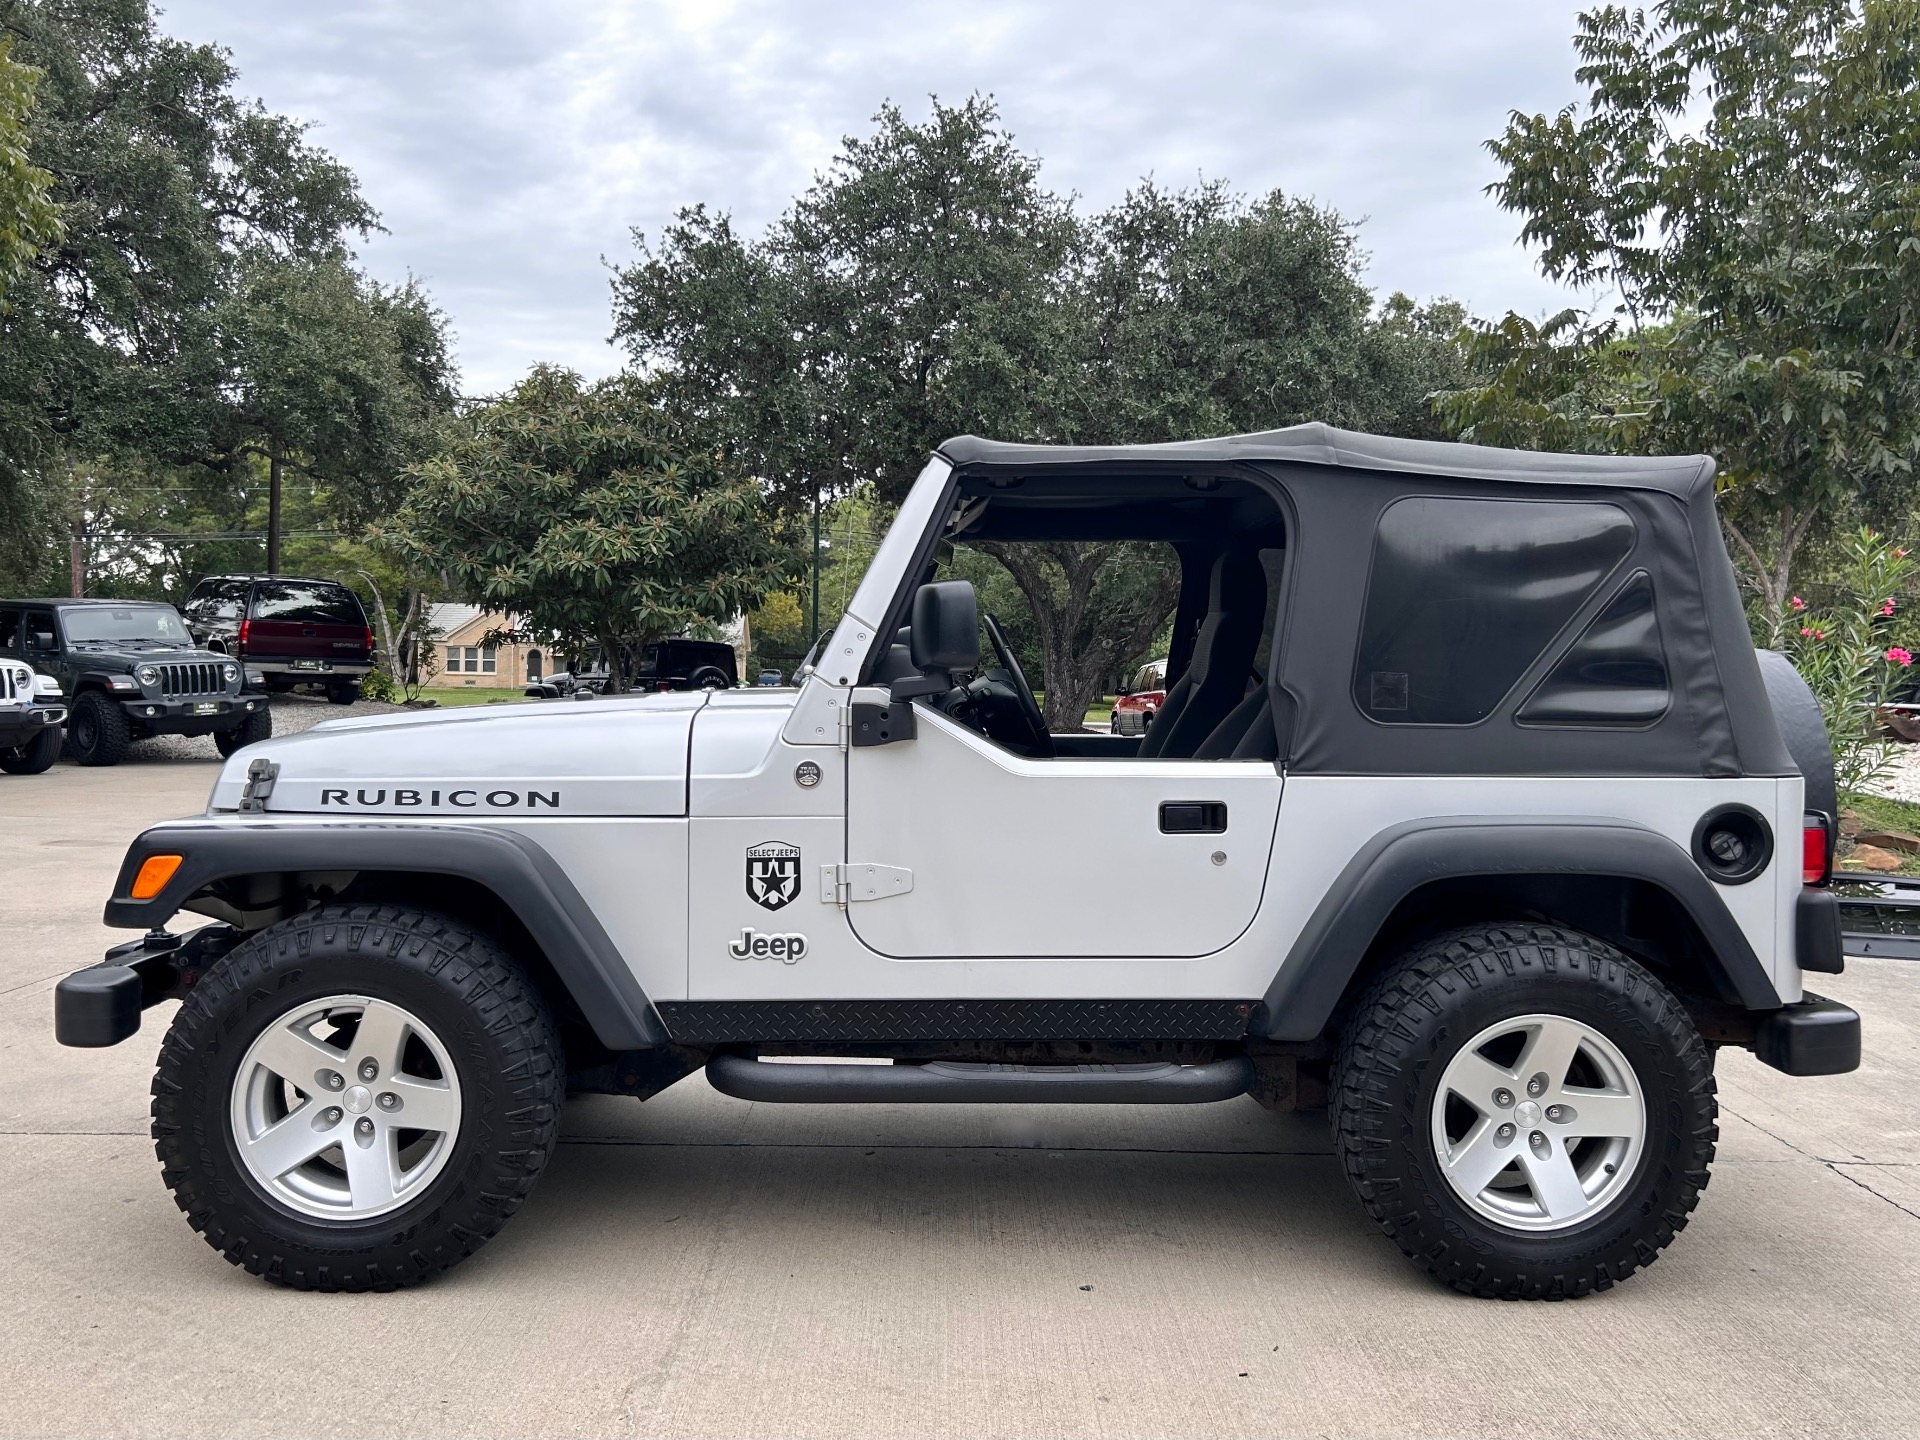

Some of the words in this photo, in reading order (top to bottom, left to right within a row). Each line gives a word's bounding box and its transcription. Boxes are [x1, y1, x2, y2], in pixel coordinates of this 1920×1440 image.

[702, 676, 724, 685] SELECT
[321, 789, 560, 808] RUBICON
[731, 932, 805, 960] Jeep
